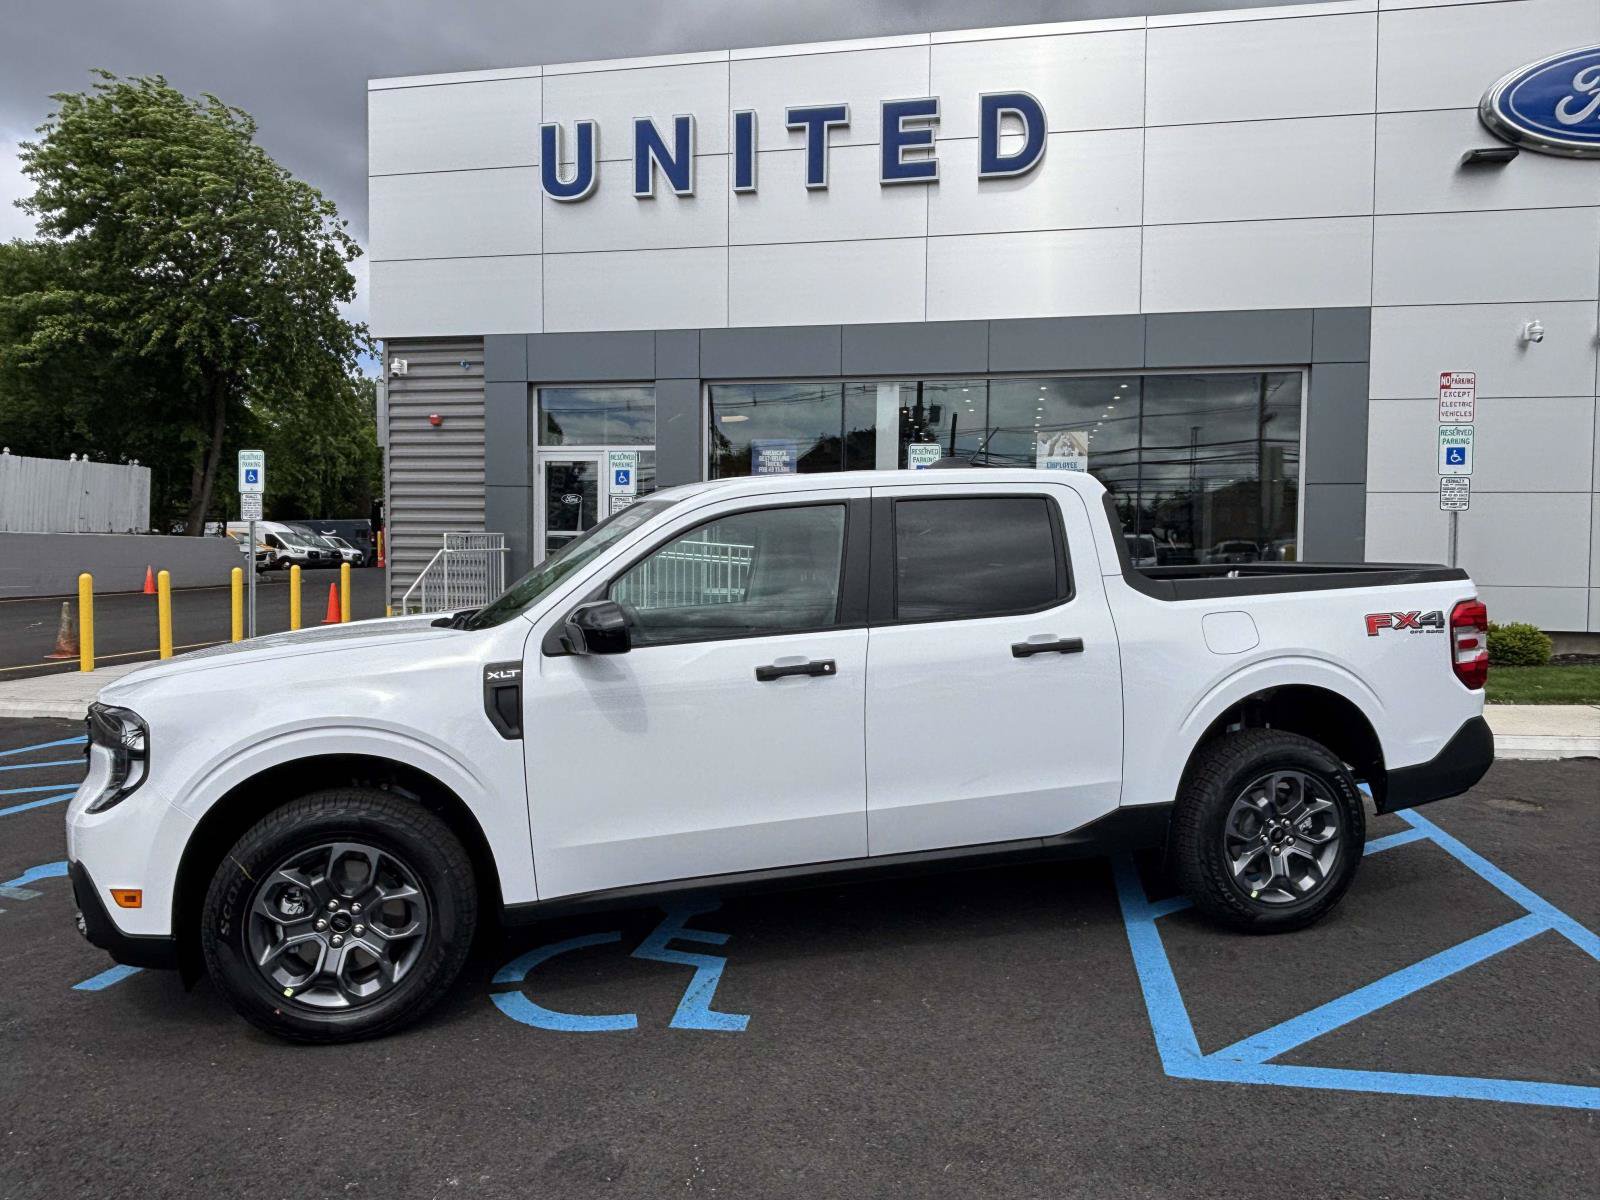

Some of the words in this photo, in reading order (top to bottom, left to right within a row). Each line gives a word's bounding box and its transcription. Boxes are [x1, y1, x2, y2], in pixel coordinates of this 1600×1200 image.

[538, 91, 1048, 202] UNITED
[1441, 376, 1451, 386] NO
[1046, 461, 1078, 469] EMPLOYEE
[1364, 611, 1445, 636] FX4
[487, 669, 521, 680] XLT
